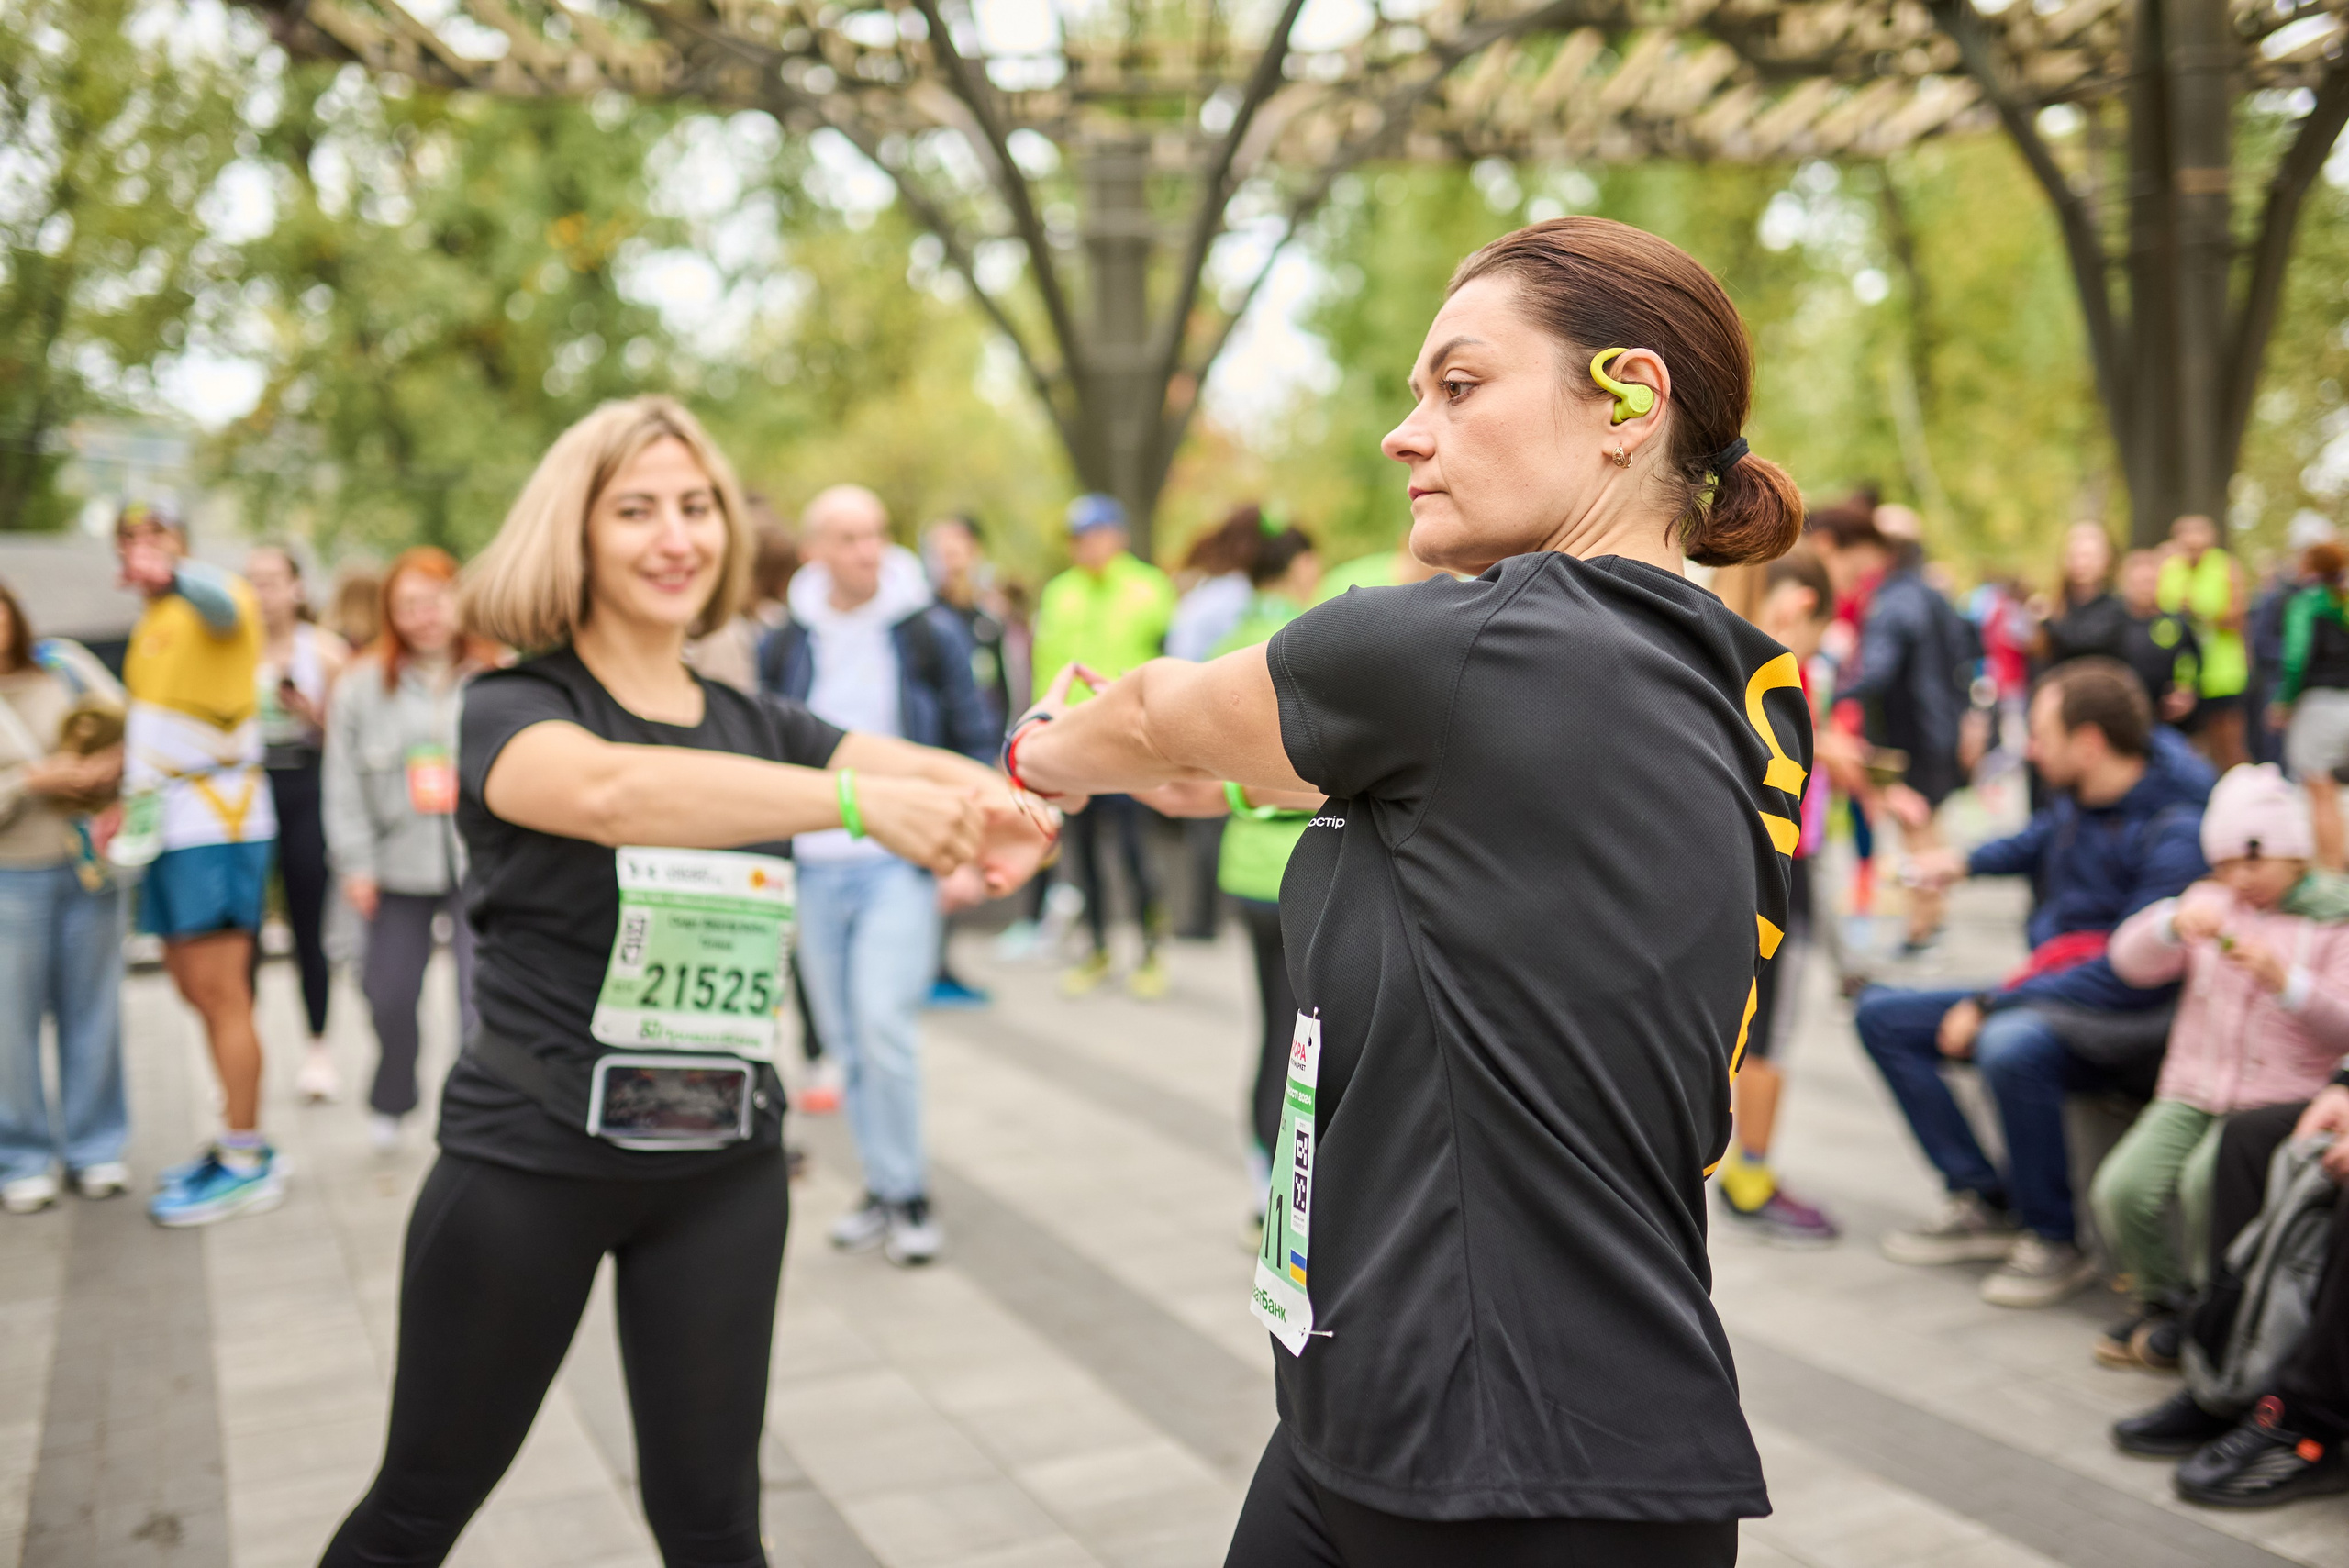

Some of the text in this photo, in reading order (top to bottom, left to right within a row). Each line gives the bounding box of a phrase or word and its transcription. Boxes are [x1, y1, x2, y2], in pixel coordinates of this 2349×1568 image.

[1308, 815, 1346, 829] остір
[640, 963, 770, 1015] 21525
[1298, 1091, 1312, 1106] 2024
[1252, 1284, 1286, 1323] атБанк
